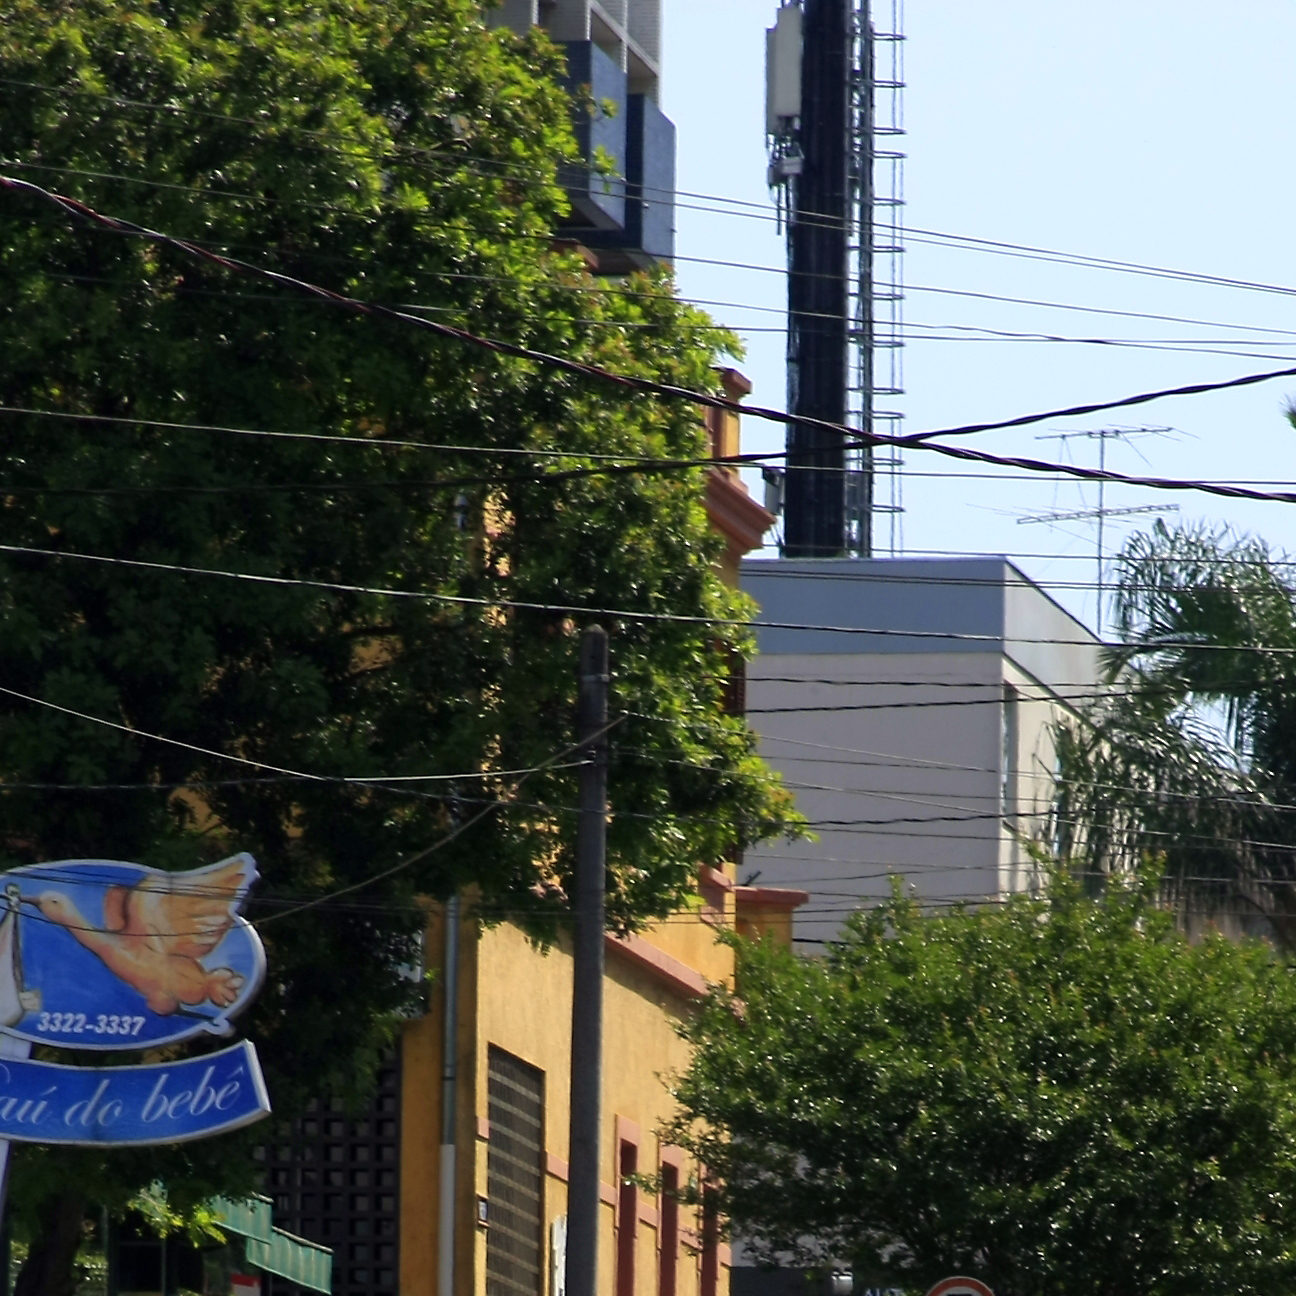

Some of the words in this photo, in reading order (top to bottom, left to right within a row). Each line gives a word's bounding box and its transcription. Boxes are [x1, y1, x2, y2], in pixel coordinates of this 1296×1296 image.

[36, 1011, 146, 1037] 3322-3337
[64, 1079, 124, 1127] do
[140, 1064, 245, 1123] bebê
